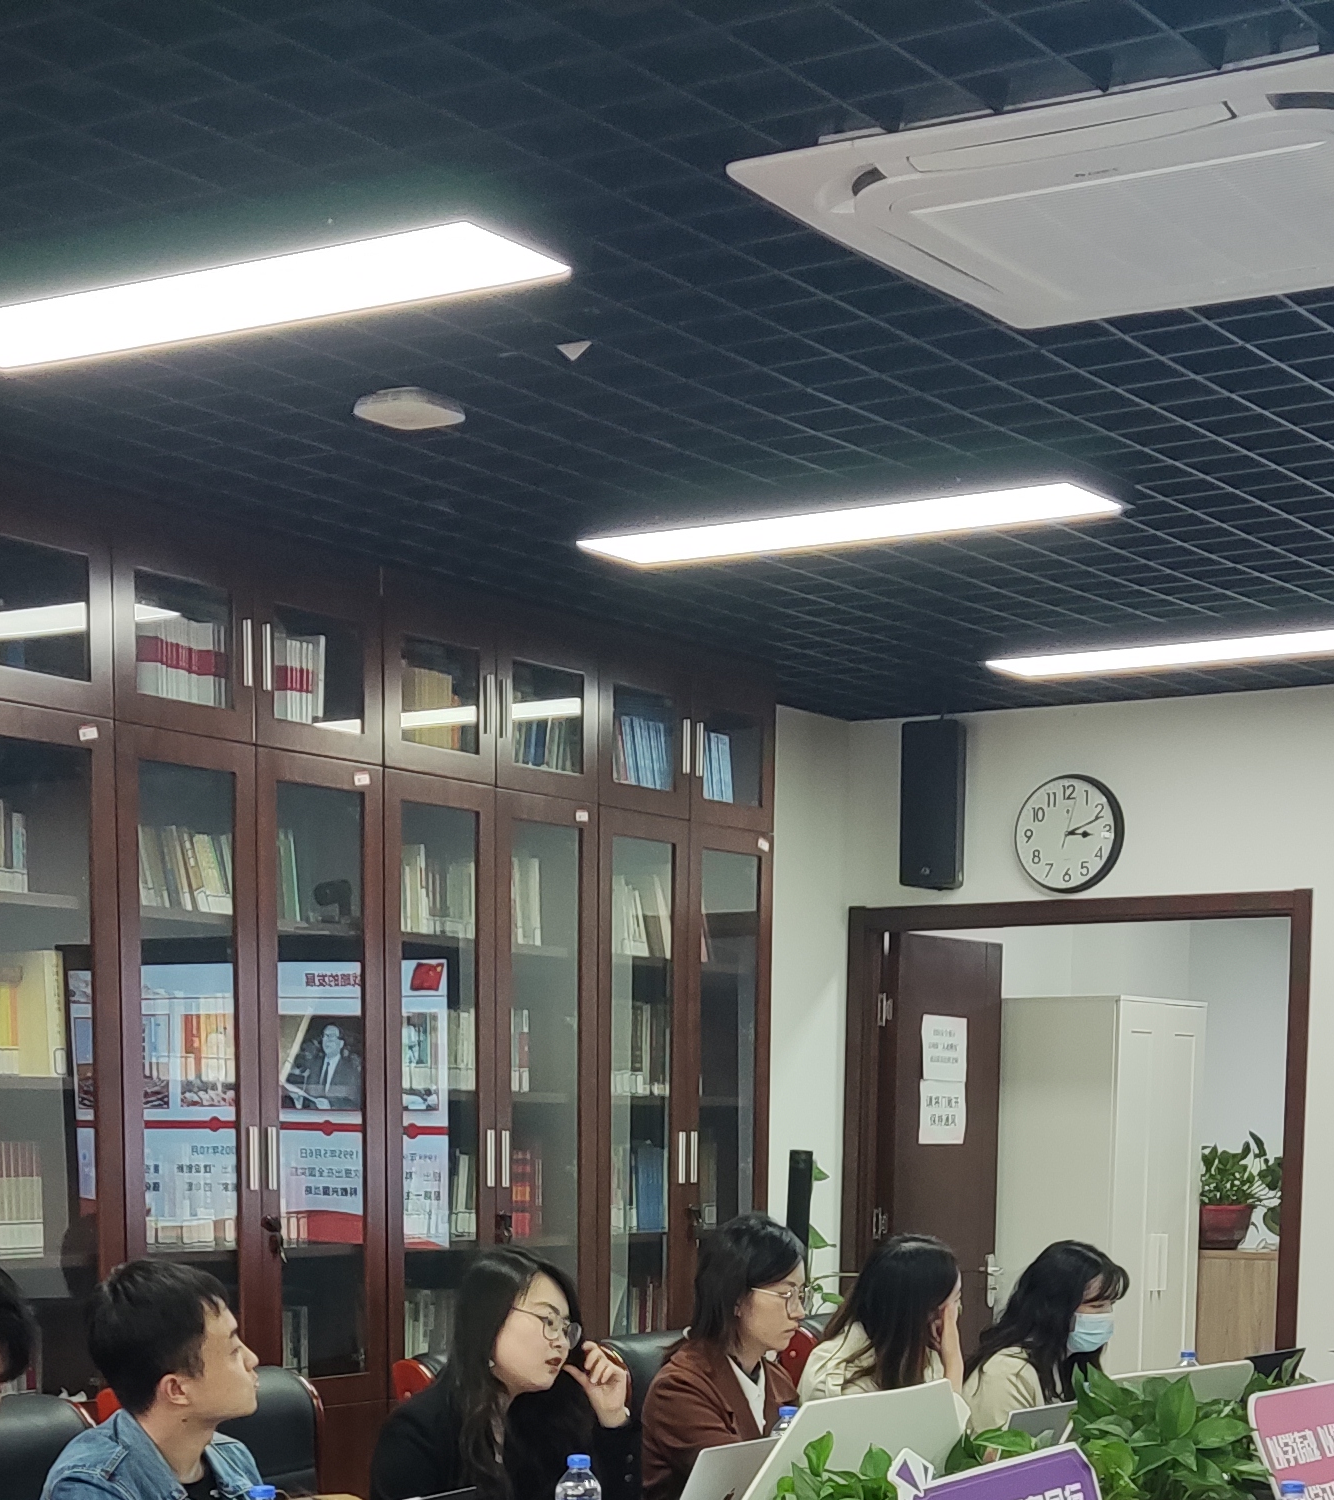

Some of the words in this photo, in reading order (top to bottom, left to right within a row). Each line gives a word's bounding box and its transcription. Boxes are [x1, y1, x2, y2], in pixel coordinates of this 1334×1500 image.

[1046, 792, 1056, 807] 11
[1062, 784, 1077, 800] 12
[1084, 790, 1089, 806] 1
[1032, 807, 1045, 823] 10
[1095, 803, 1104, 818] 2
[1024, 829, 1033, 843] 9
[1103, 824, 1112, 839] 3
[1032, 849, 1041, 864] 8
[1094, 846, 1103, 860] 4
[1045, 863, 1054, 878] 7
[1063, 868, 1071, 882] 6
[1080, 861, 1089, 876] 5
